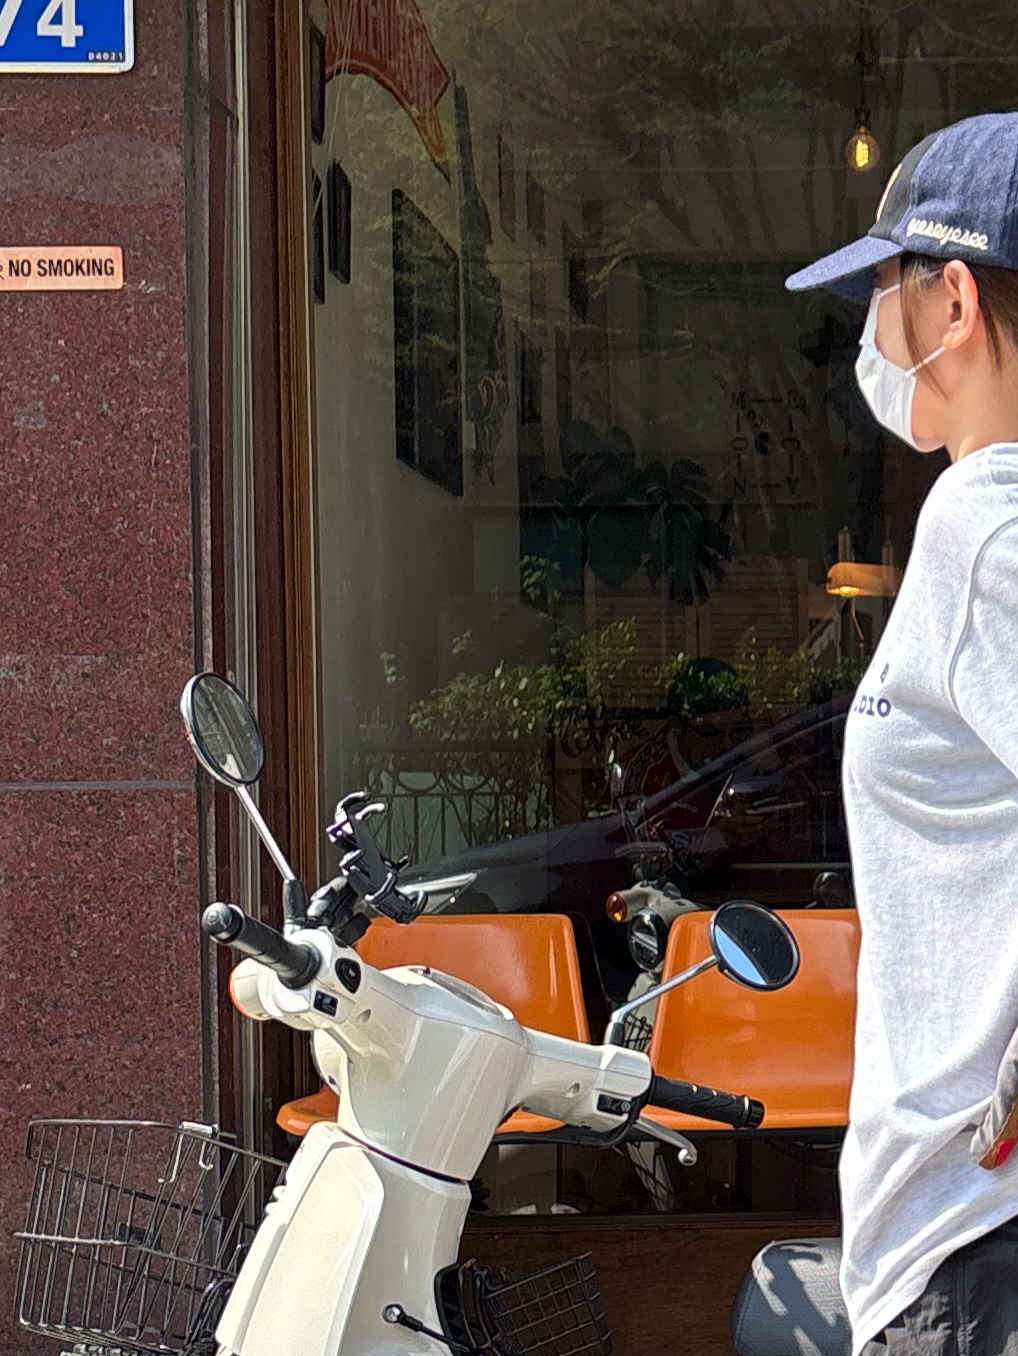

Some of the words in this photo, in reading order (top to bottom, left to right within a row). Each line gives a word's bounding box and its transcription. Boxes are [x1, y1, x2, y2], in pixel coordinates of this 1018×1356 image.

[88, 52, 123, 61] 04021
[906, 217, 989, 250] yeseyesee
[8, 258, 31, 277] NO
[37, 258, 115, 277] SMOKING
